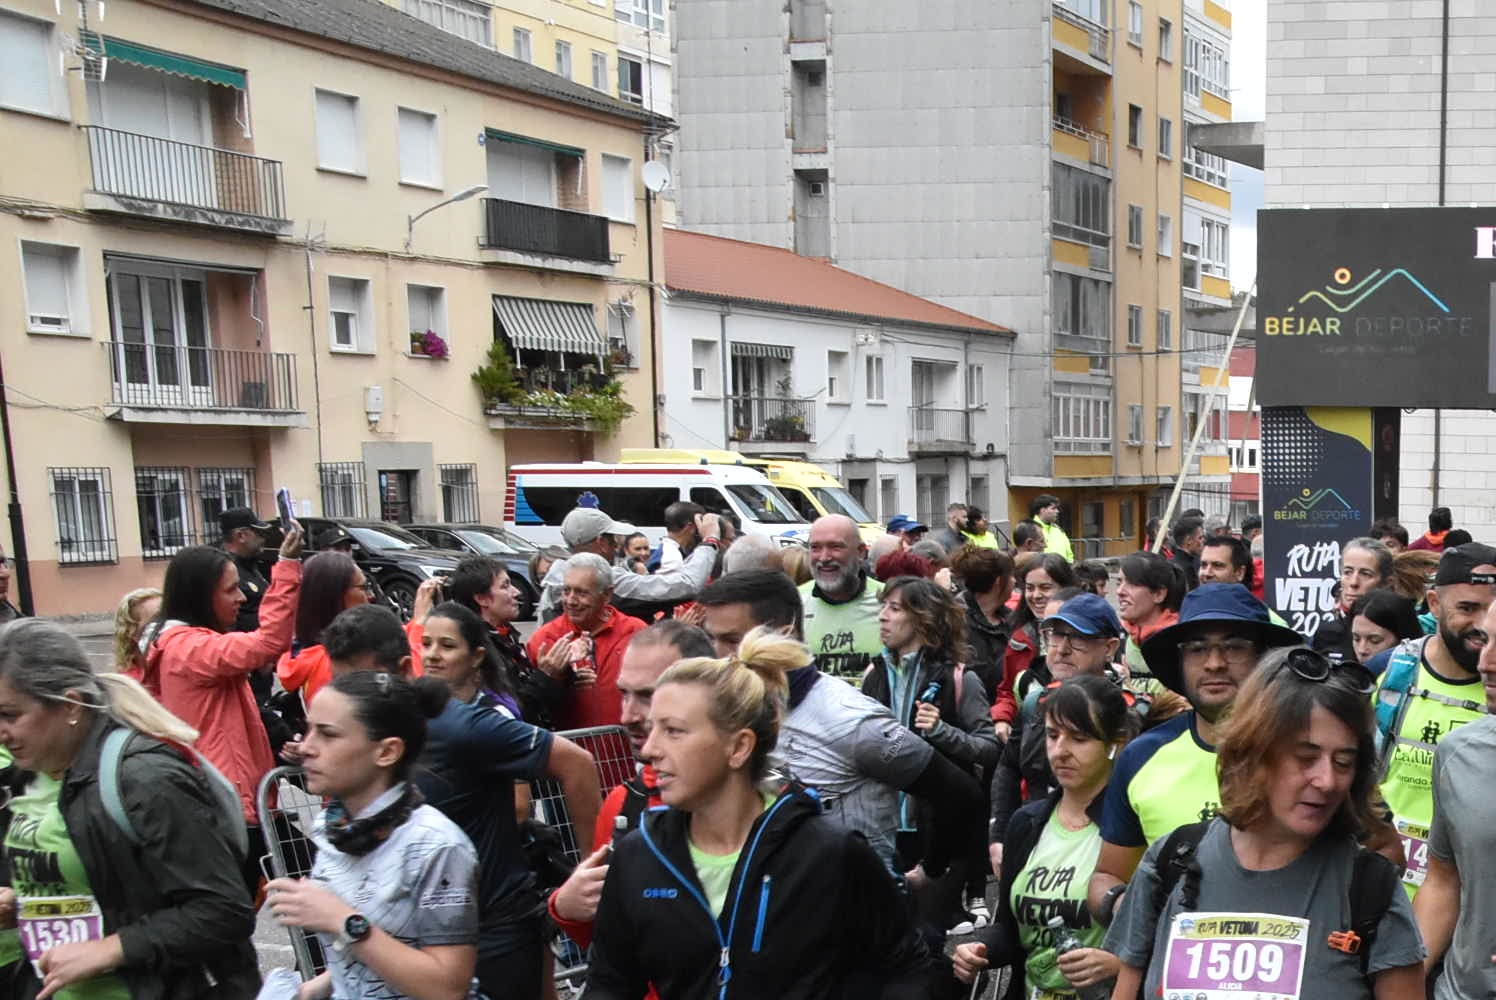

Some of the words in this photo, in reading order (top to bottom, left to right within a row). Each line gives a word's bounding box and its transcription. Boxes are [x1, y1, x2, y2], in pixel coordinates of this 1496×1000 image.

[1265, 306, 1342, 336] BÉJAR
[1311, 510, 1361, 521] DEPORTE
[1286, 540, 1343, 578] RUTA
[820, 630, 855, 653] RUTA
[1025, 866, 1077, 898] RUTA
[22, 918, 89, 953] 1530
[1219, 920, 1260, 936] VETONA
[1261, 922, 1304, 940] 2025
[1186, 942, 1284, 983] 1509
